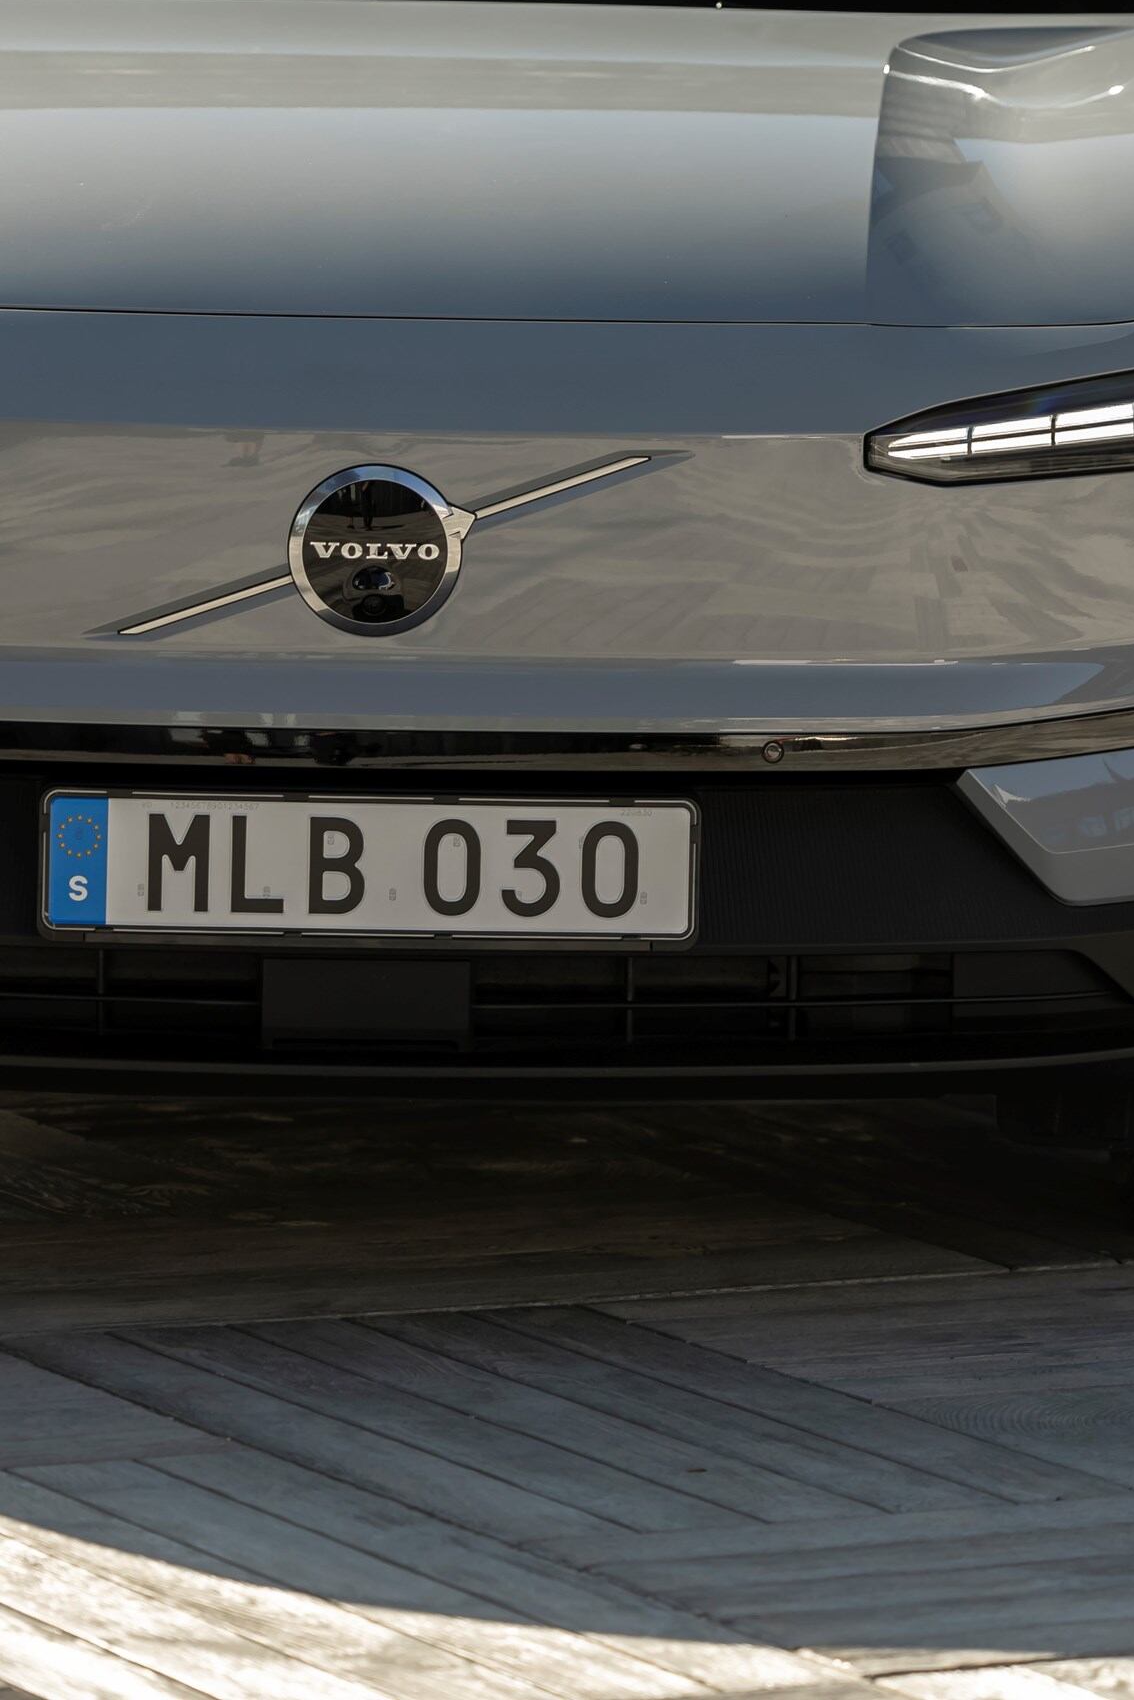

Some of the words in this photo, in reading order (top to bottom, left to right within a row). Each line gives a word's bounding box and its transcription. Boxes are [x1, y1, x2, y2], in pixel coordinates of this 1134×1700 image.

[310, 541, 440, 561] VOLVO
[147, 813, 366, 915] MLB
[422, 818, 640, 919] 030
[69, 875, 88, 901] S
